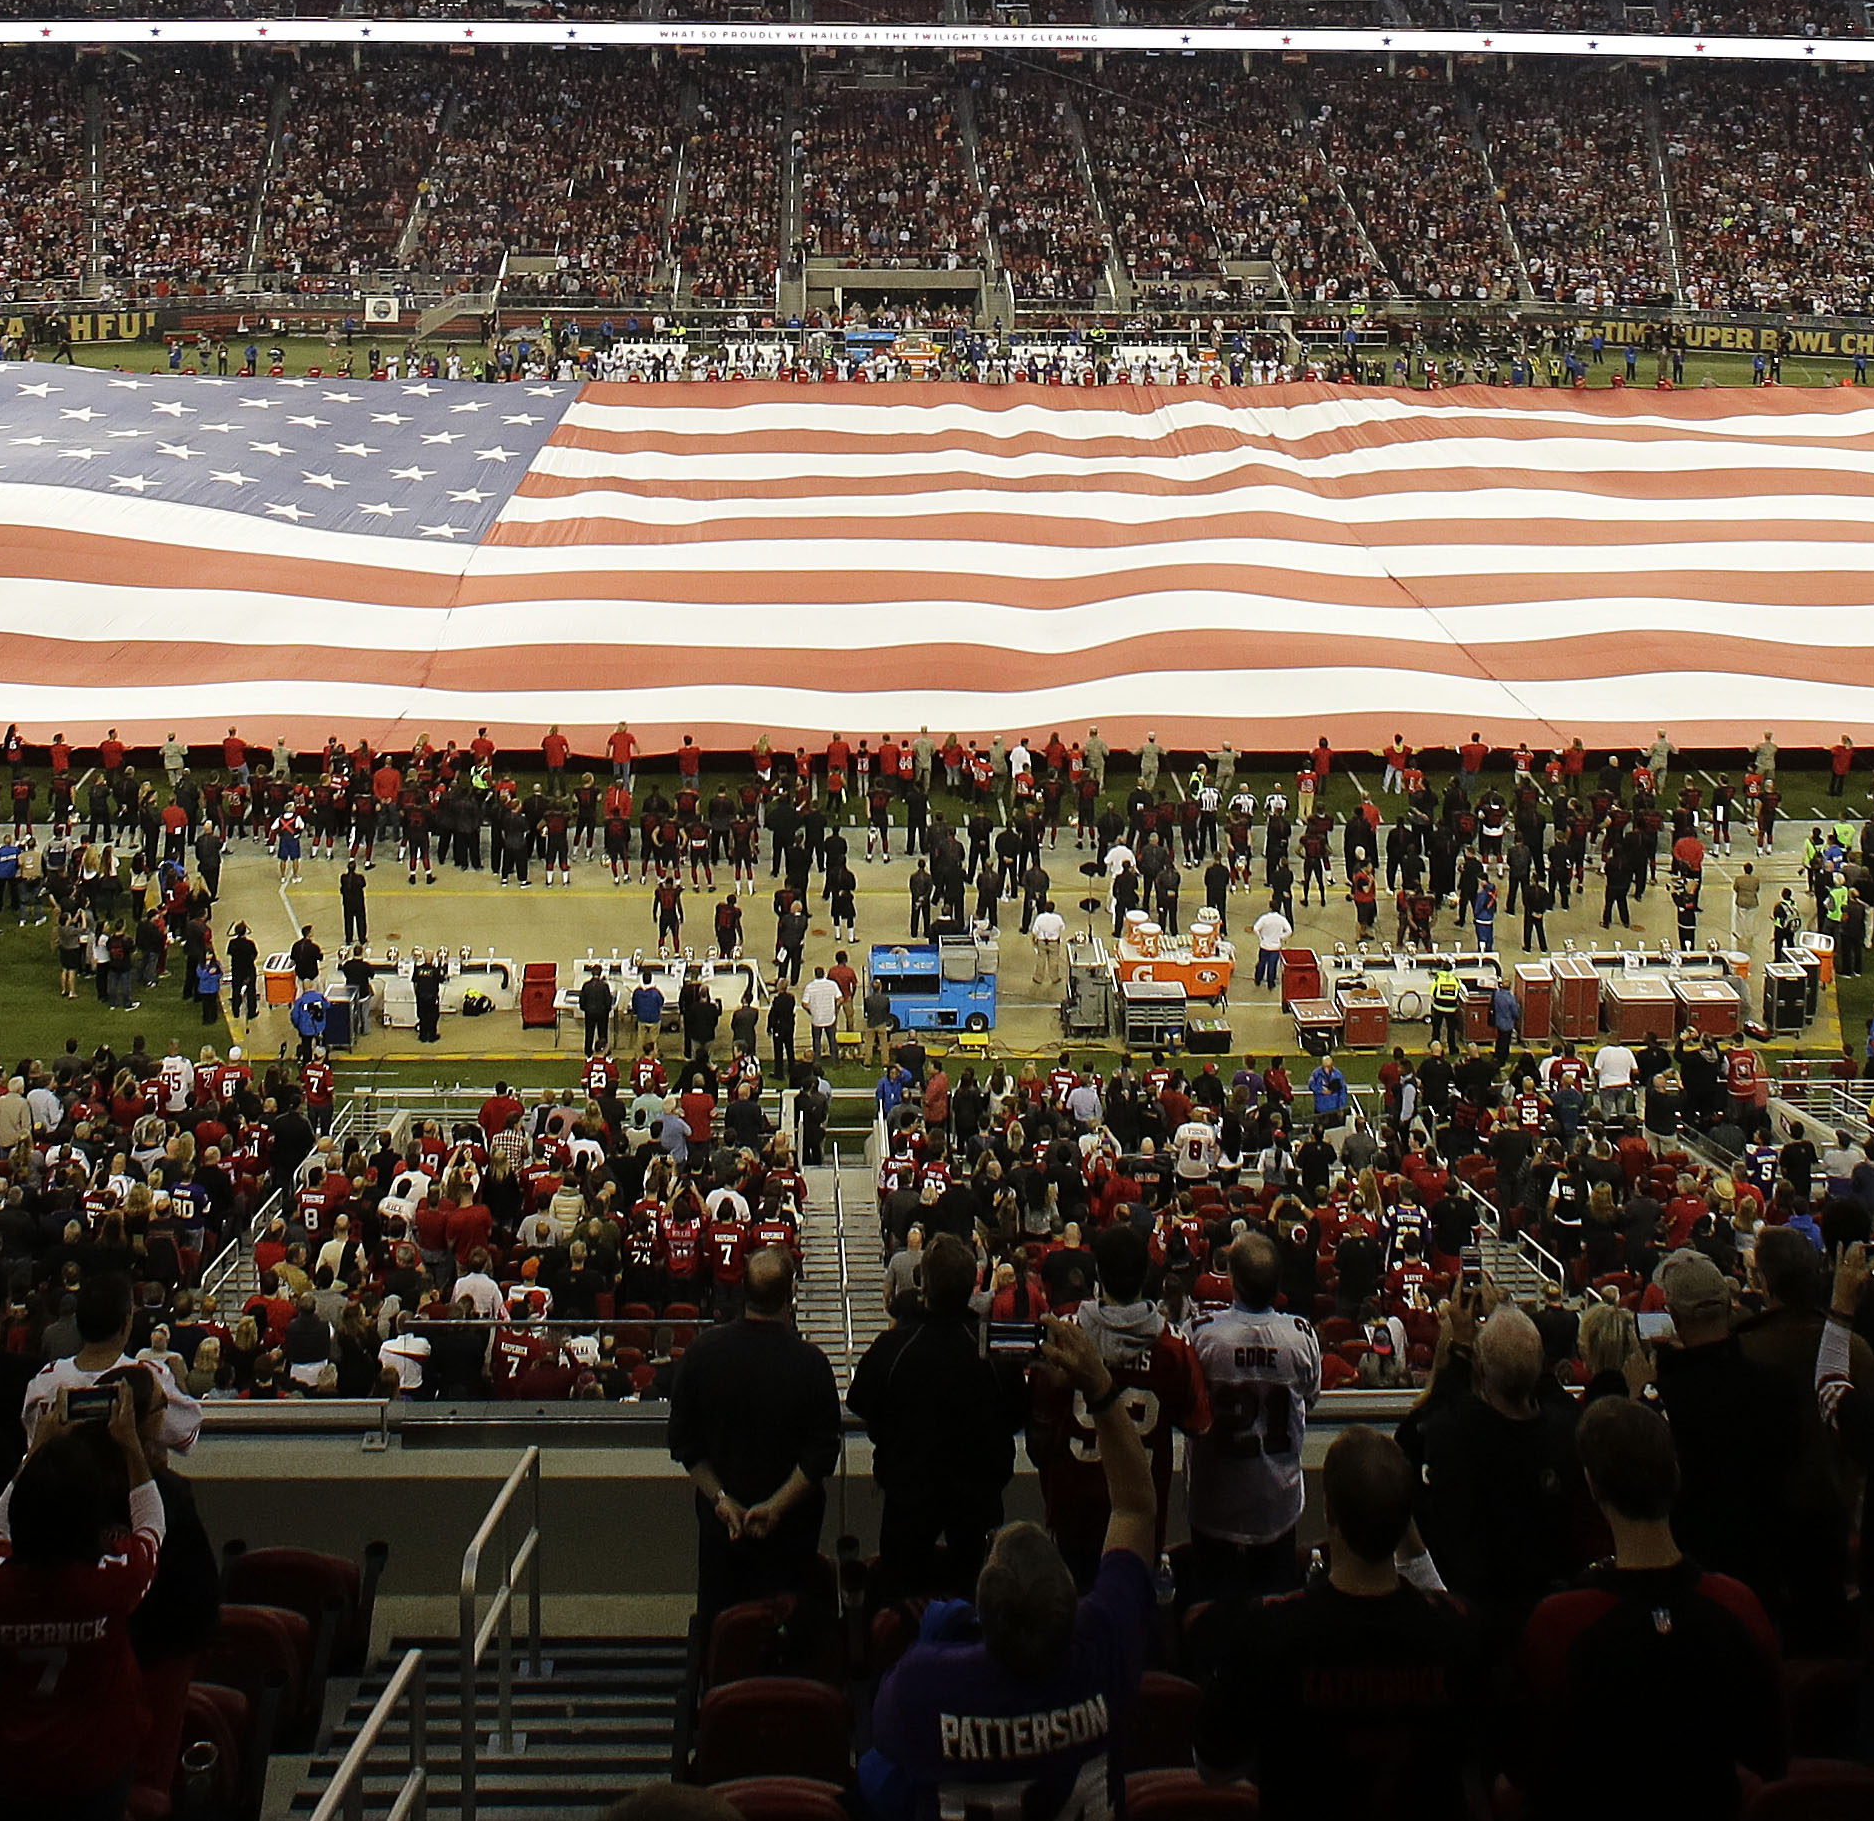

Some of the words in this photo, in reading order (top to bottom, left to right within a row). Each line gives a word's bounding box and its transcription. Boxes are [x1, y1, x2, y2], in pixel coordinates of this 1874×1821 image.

[722, 31, 782, 39] PROUDLY
[811, 32, 858, 40] HAILED
[914, 33, 988, 41] TWILIGHT'S
[1031, 34, 1099, 42] GLEAMING
[310, 1077, 319, 1094] 7
[589, 1071, 606, 1088] 23
[1155, 1080, 1164, 1095] 7
[1058, 1083, 1069, 1102] 7
[1521, 1107, 1539, 1125] 52
[1188, 1140, 1203, 1161] 8
[1760, 1163, 1772, 1181] 5
[171, 1199, 195, 1220] 80
[304, 1207, 318, 1230] 8
[721, 1244, 732, 1266] 7
[507, 1355, 521, 1379] 7
[1234, 1346, 1278, 1370] GORE
[1214, 1384, 1290, 1458] 21
[14, 1647, 69, 1698] 7
[939, 1693, 1110, 1761] PATTERSON
